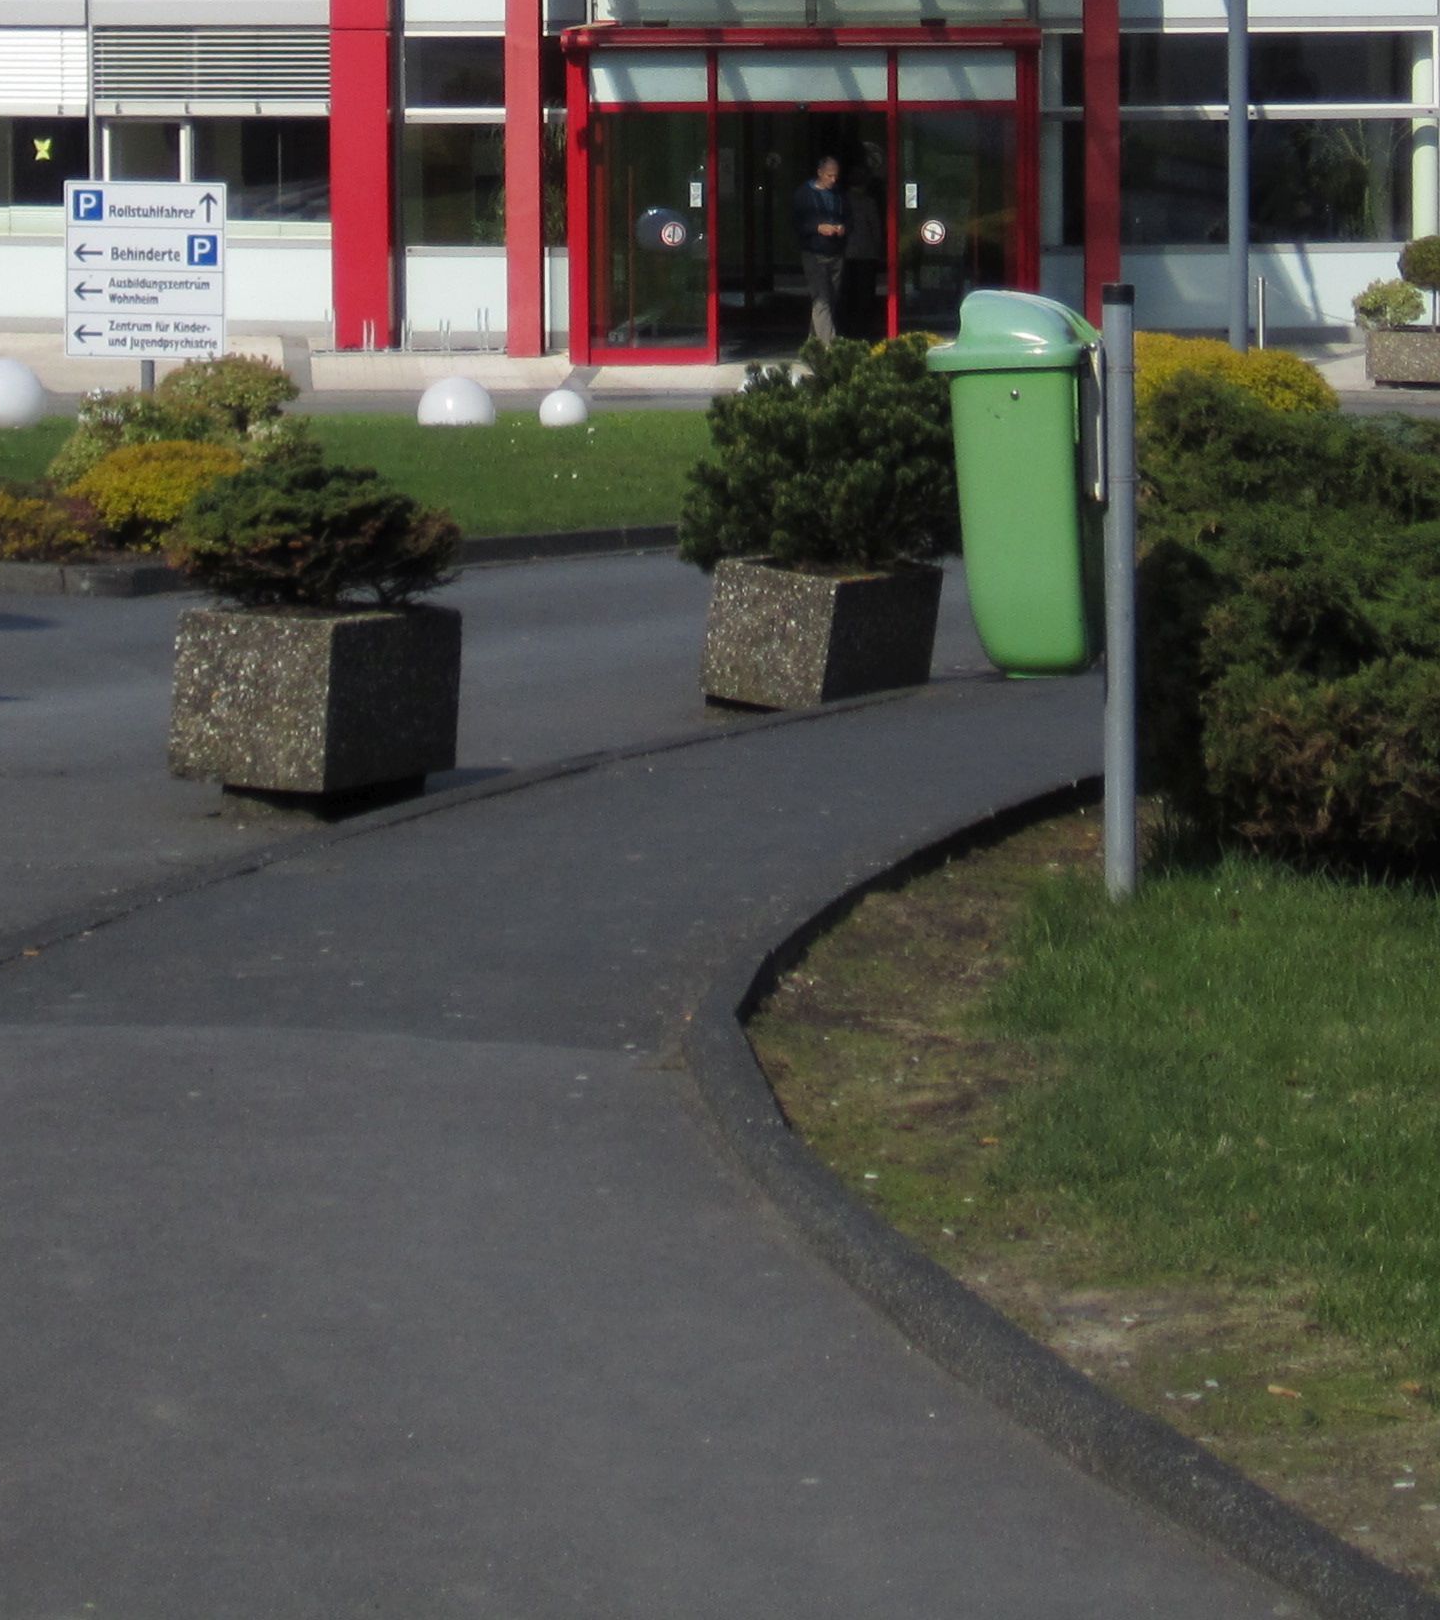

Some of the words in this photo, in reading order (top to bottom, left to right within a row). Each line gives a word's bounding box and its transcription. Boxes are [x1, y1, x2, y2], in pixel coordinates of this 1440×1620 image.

[79, 192, 97, 218] P
[109, 205, 196, 219] Rollstuhlfahrer
[111, 246, 181, 262] Behinderte
[193, 238, 211, 262] P
[109, 277, 210, 292] Ausbildungszentrum
[109, 294, 159, 305] Wohnheim
[108, 320, 153, 332] Zentrum
[154, 320, 170, 333] für
[173, 321, 211, 333] Kinder-
[108, 336, 127, 348] und
